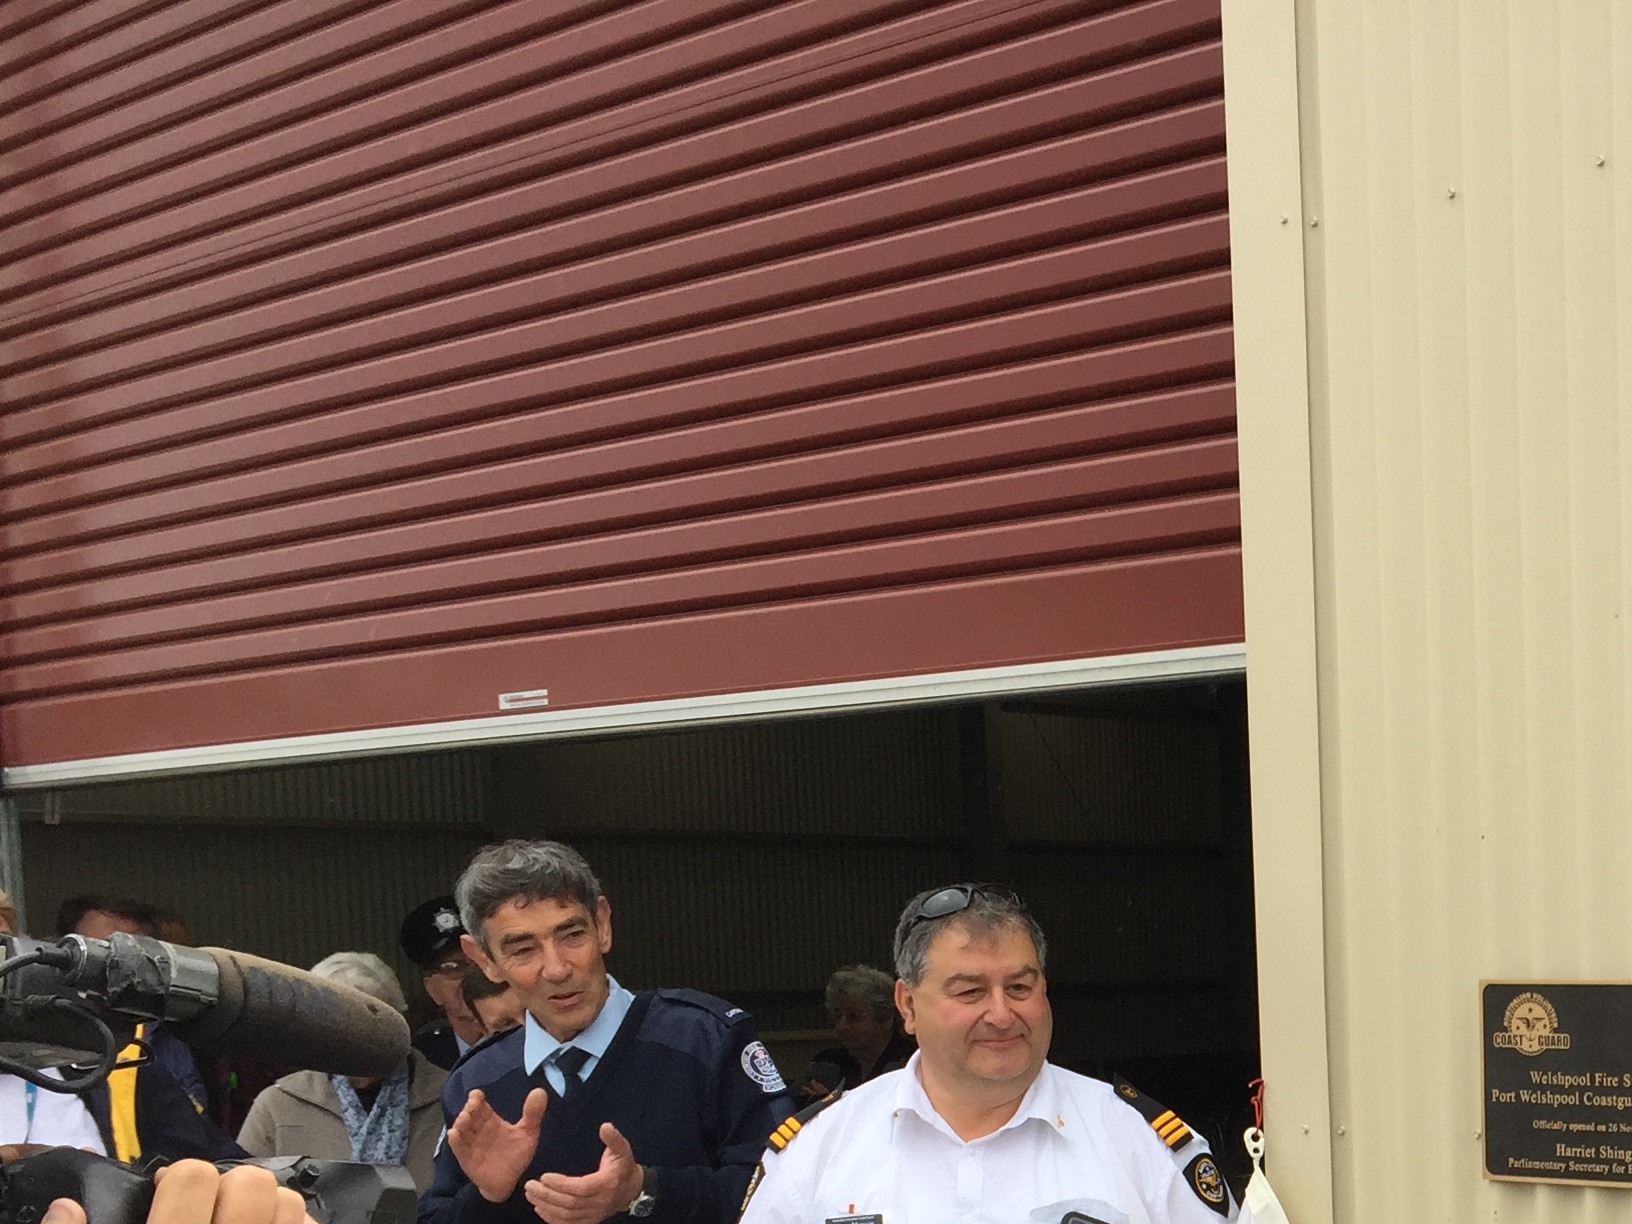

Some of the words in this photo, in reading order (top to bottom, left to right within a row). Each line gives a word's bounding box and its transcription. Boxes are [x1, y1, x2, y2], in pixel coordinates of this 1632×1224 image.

[1494, 1033, 1524, 1047] COAST
[1537, 1034, 1569, 1048] GUARD
[1529, 1071, 1591, 1088] Welshpool
[1594, 1072, 1619, 1087] Fire
[1491, 1089, 1516, 1102] Port
[1519, 1090, 1580, 1107] Welshpool
[1532, 1120, 1567, 1132] Officially
[1569, 1123, 1595, 1132] opened
[1608, 1123, 1618, 1132] 26
[1556, 1143, 1596, 1158] Harriet
[1599, 1145, 1632, 1162] Shing
[1508, 1157, 1566, 1173] Parliamentary
[1569, 1161, 1610, 1175] Secretary
[1612, 1163, 1625, 1174] for
